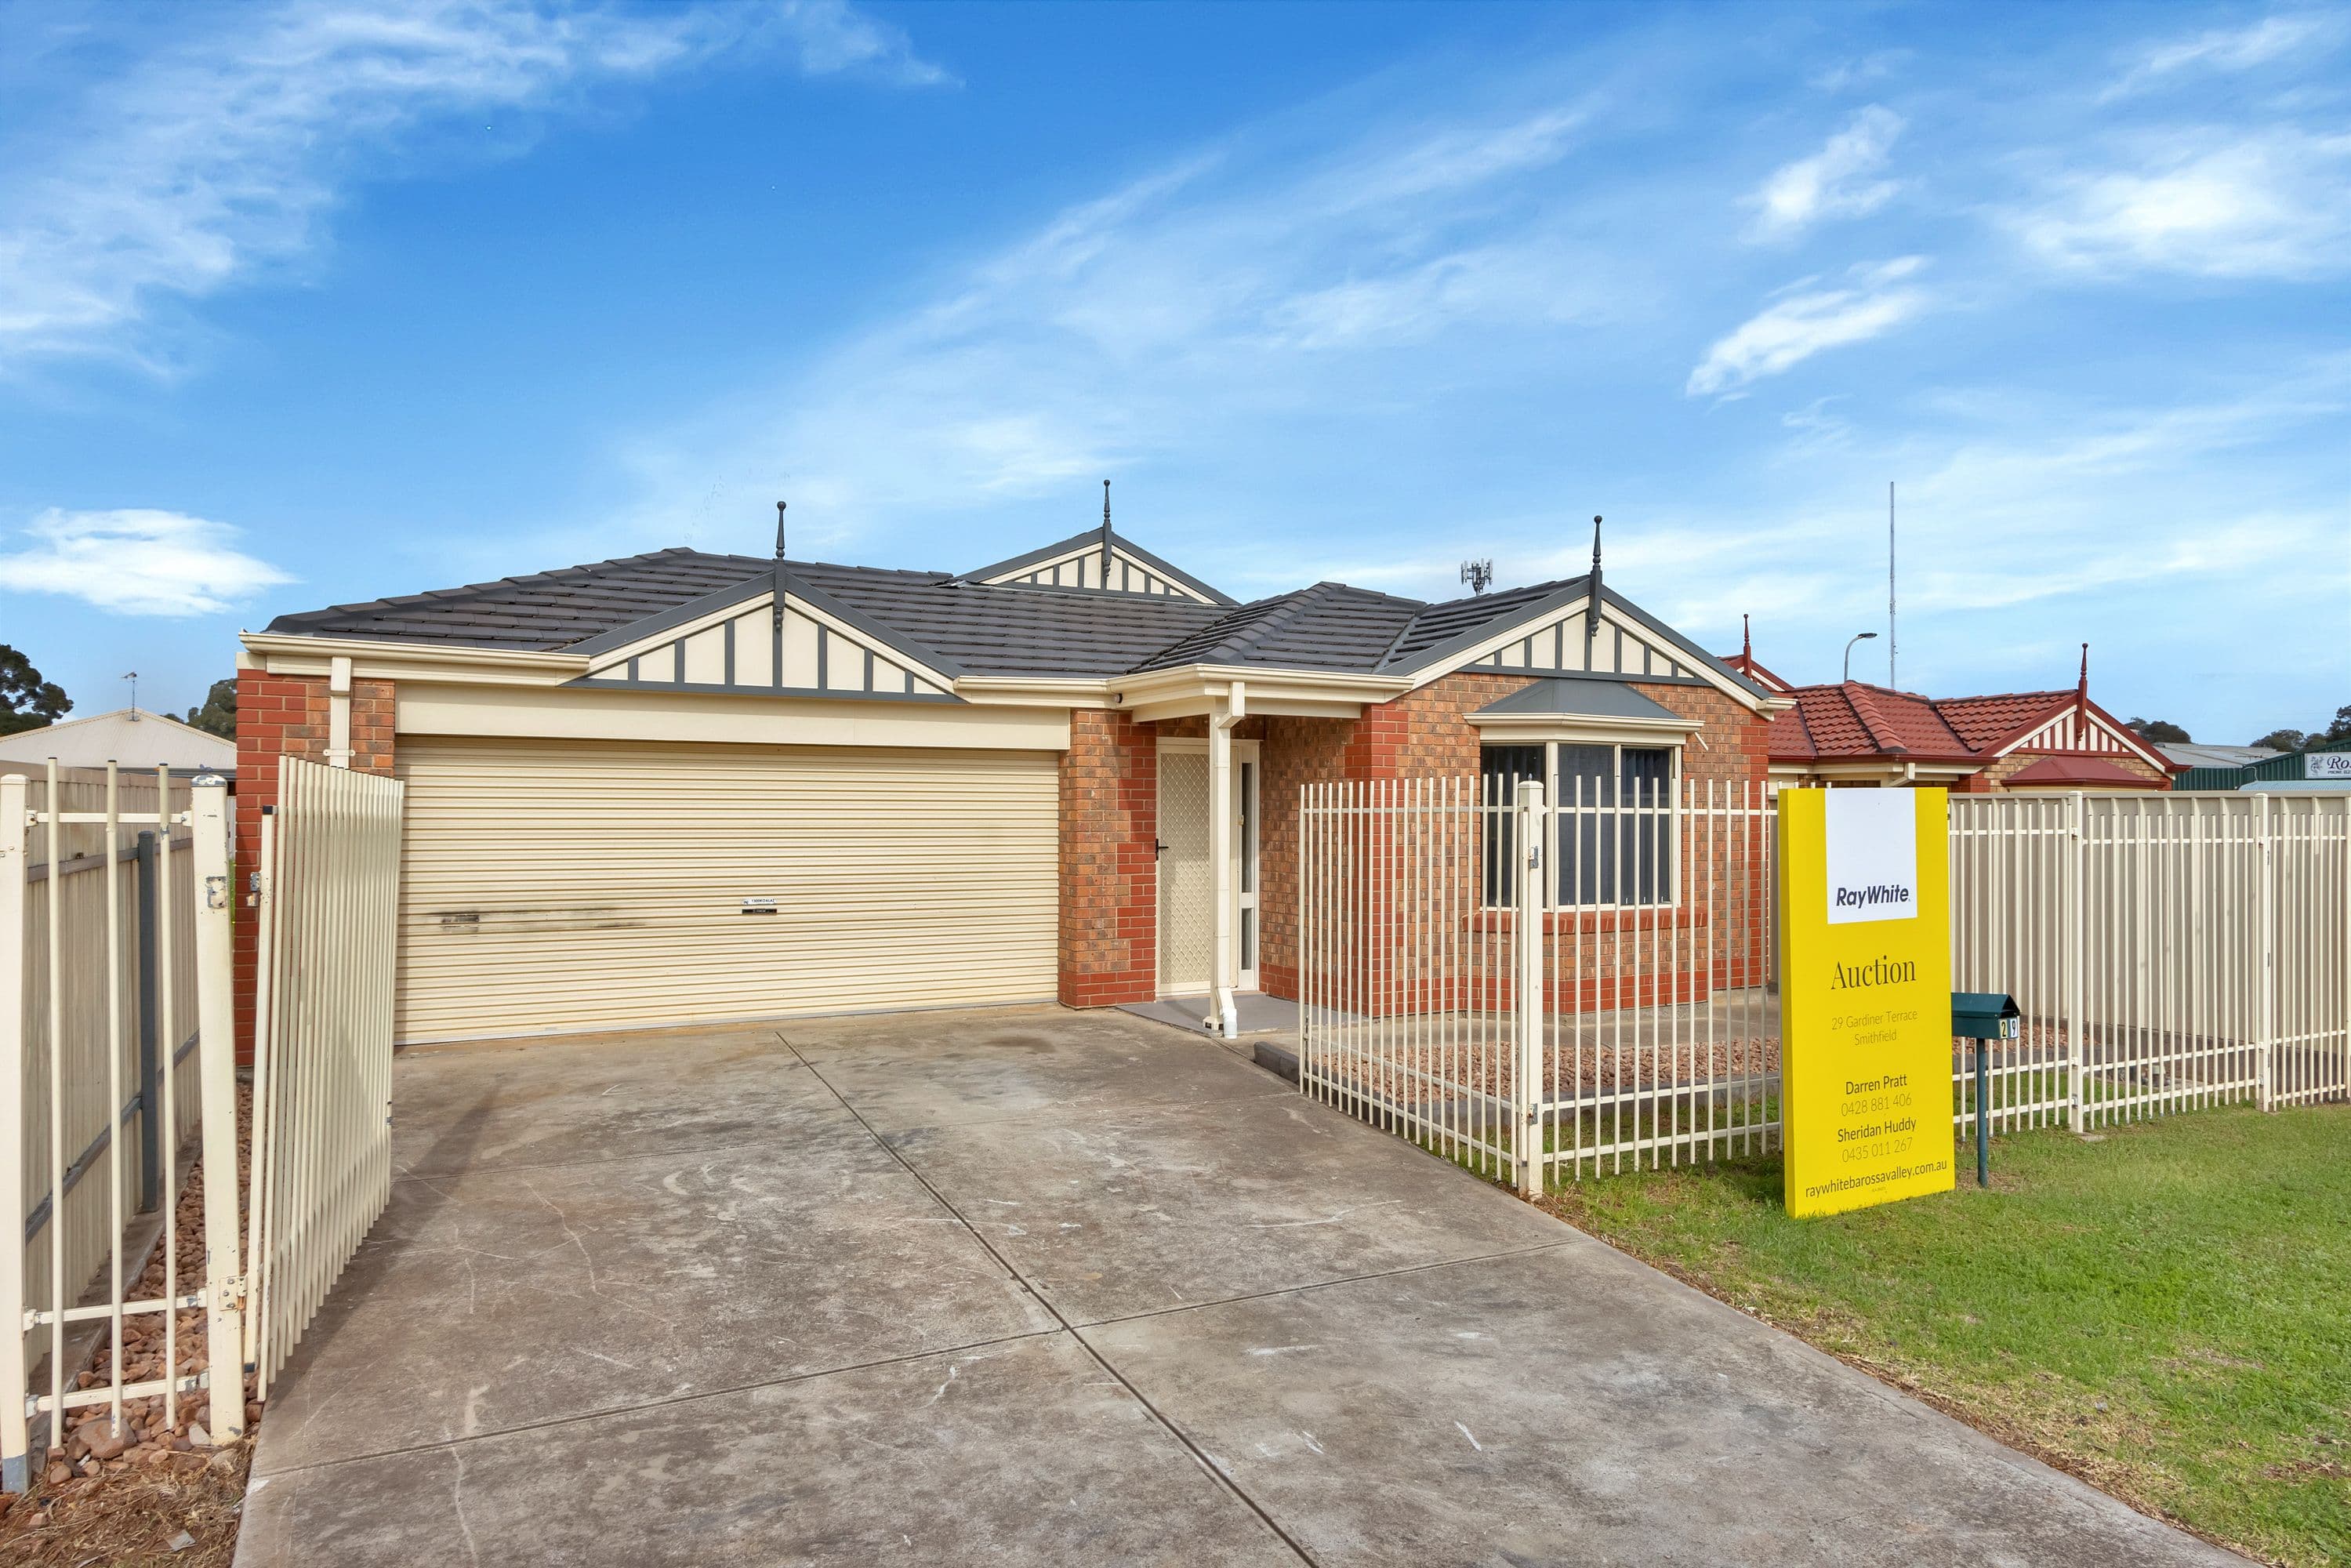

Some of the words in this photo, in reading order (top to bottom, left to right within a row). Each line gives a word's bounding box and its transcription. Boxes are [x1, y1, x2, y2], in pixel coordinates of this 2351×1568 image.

[2327, 755, 2351, 770] Ro
[1830, 955, 1916, 990] Auction
[1831, 1016, 1844, 1030] 29
[1845, 1013, 1883, 1028] Gardiner
[1885, 1010, 1918, 1022] Terrace
[2001, 1020, 2016, 1037] 29
[1854, 1029, 1897, 1046] Smithfield
[1845, 1080, 1881, 1094] Darren
[1883, 1074, 1907, 1089] Pratt
[1841, 1099, 1868, 1116] 0428
[1870, 1097, 1890, 1112] 881
[1892, 1093, 1912, 1107] 406
[1838, 1123, 1881, 1142] Sheridan
[1884, 1116, 1917, 1134] Huddy
[1841, 1145, 1869, 1163] 0435
[1871, 1142, 1891, 1157] 011
[1894, 1137, 1913, 1153] 267
[1805, 1160, 1947, 1198] raywhitebarossavalley.com.au
